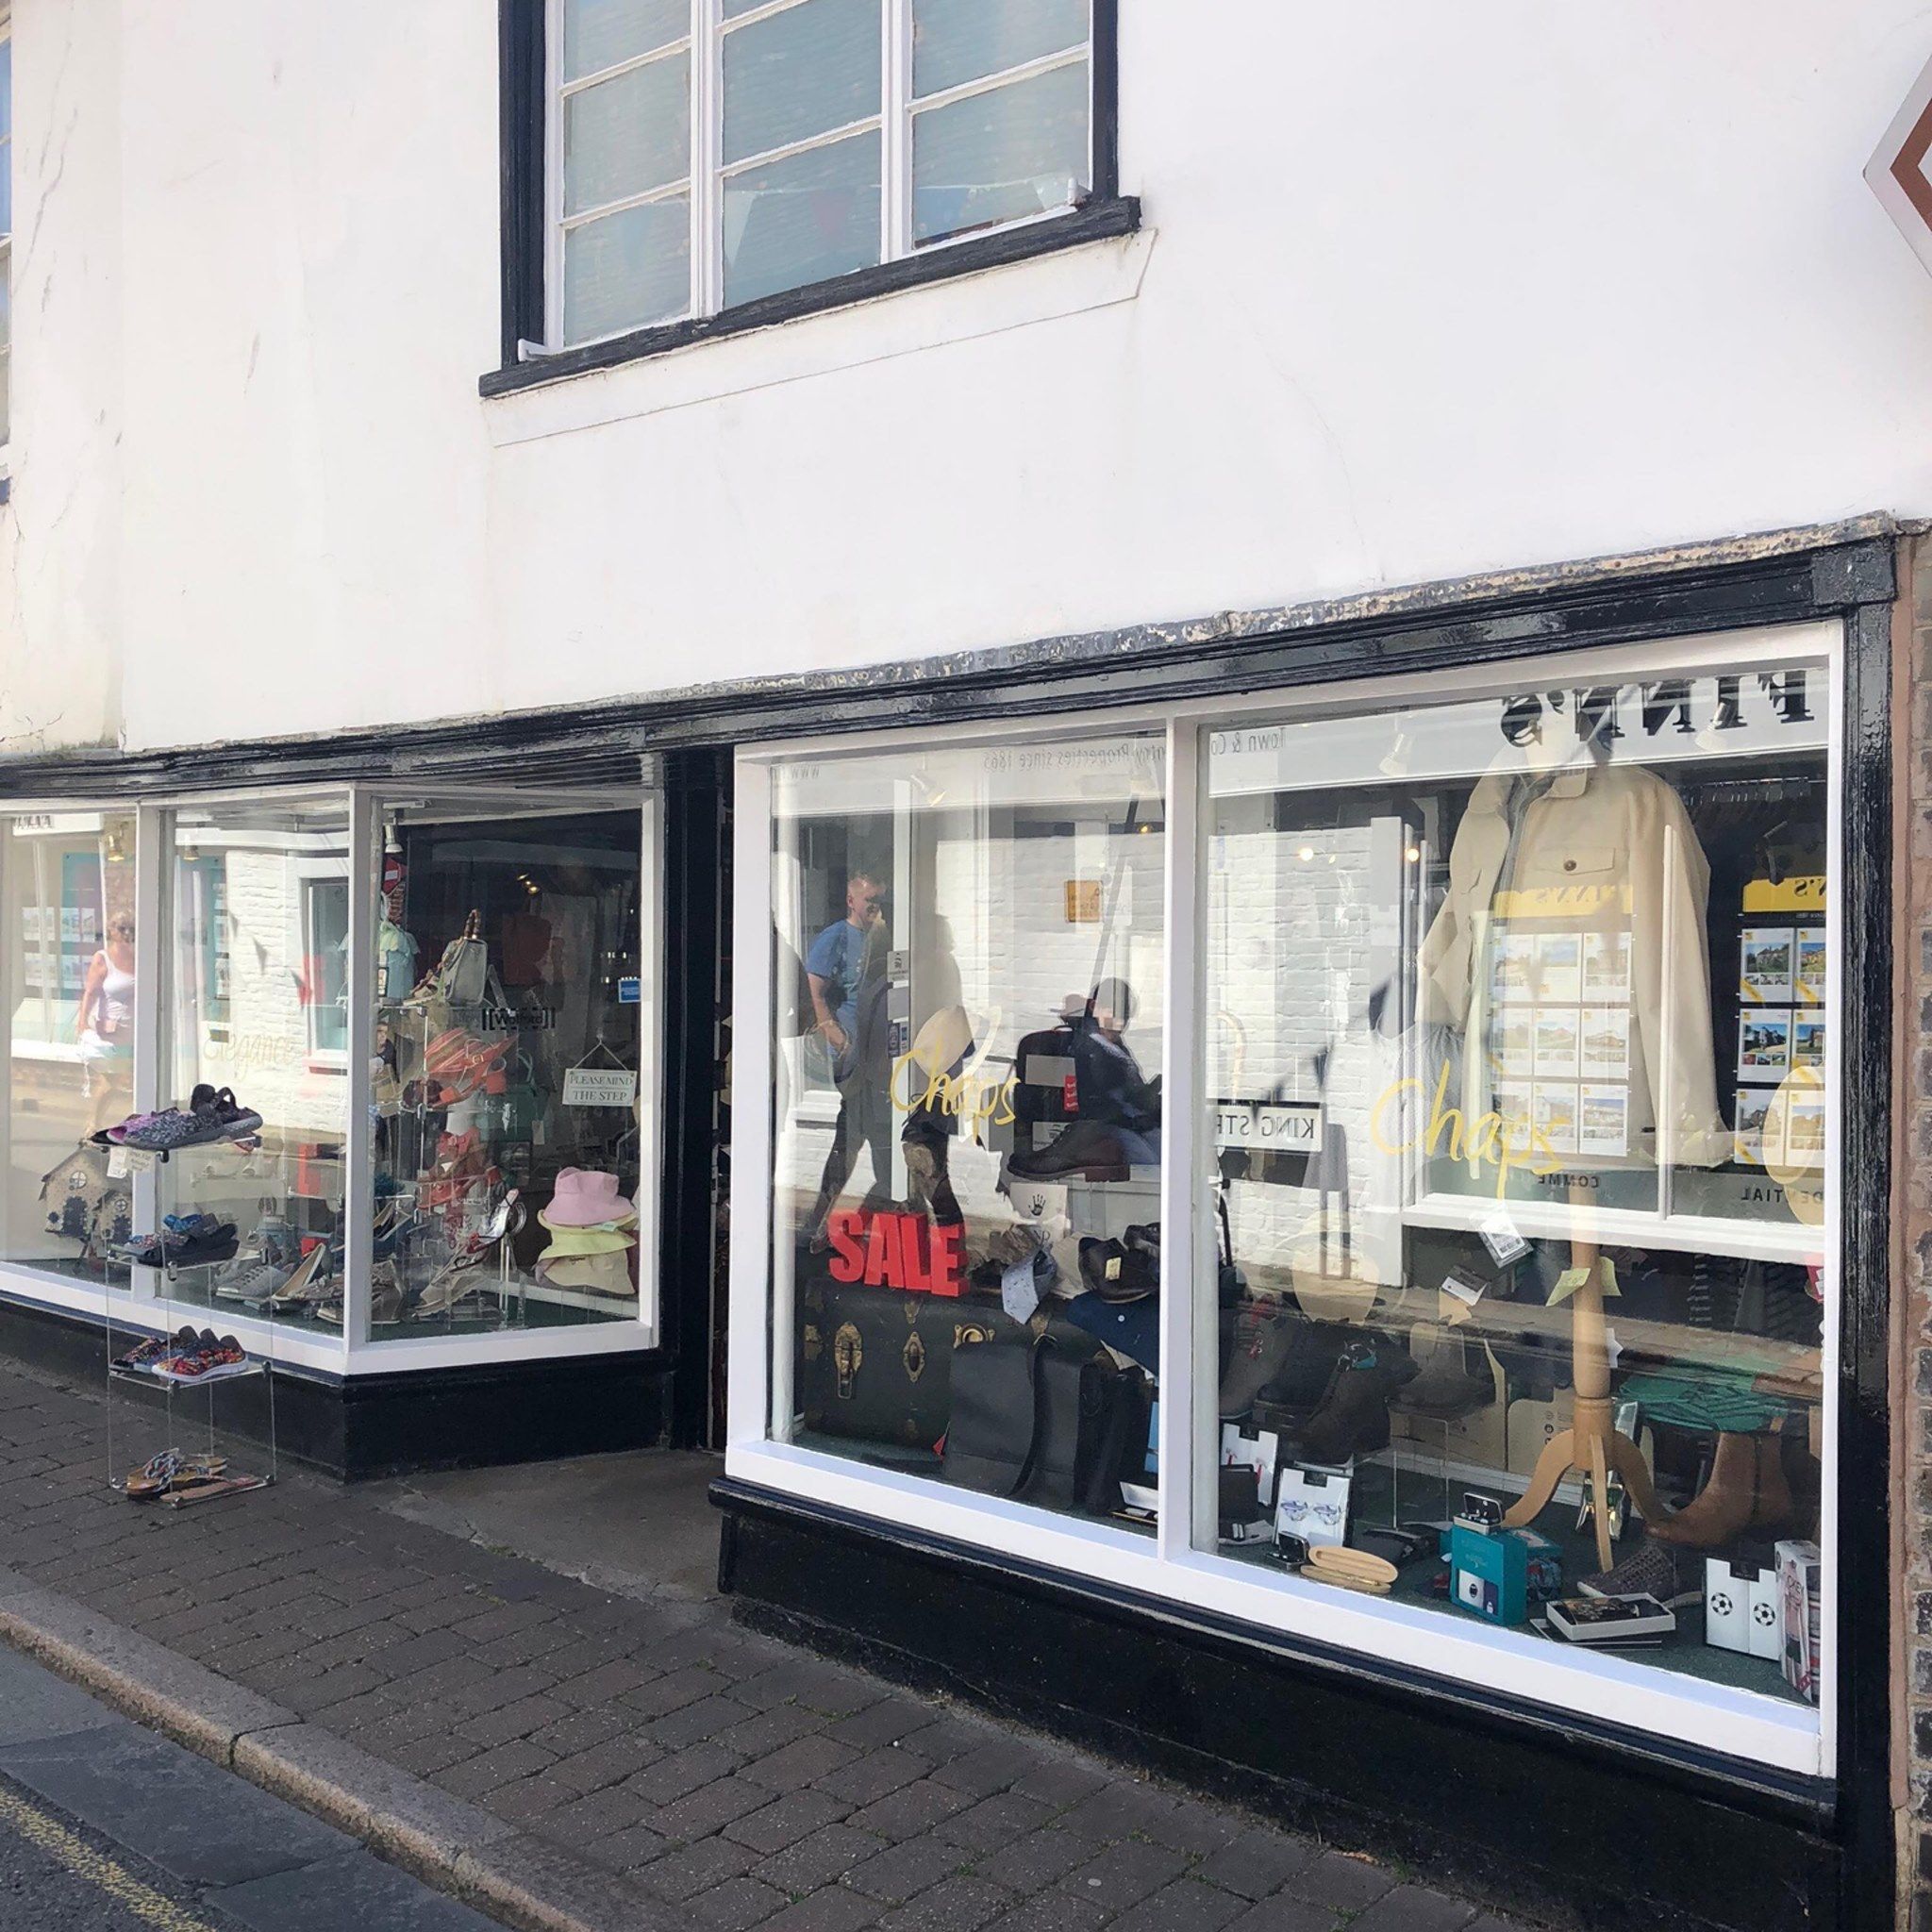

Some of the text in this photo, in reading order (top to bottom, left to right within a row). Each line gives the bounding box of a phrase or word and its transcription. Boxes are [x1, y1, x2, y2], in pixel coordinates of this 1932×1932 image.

[570, 1075, 633, 1086] PLEASE MIND
[573, 1090, 627, 1102] THE STEP
[890, 1036, 1021, 1145] Chaps
[1371, 1058, 1570, 1202] Chaps
[827, 1208, 968, 1297] SALE
